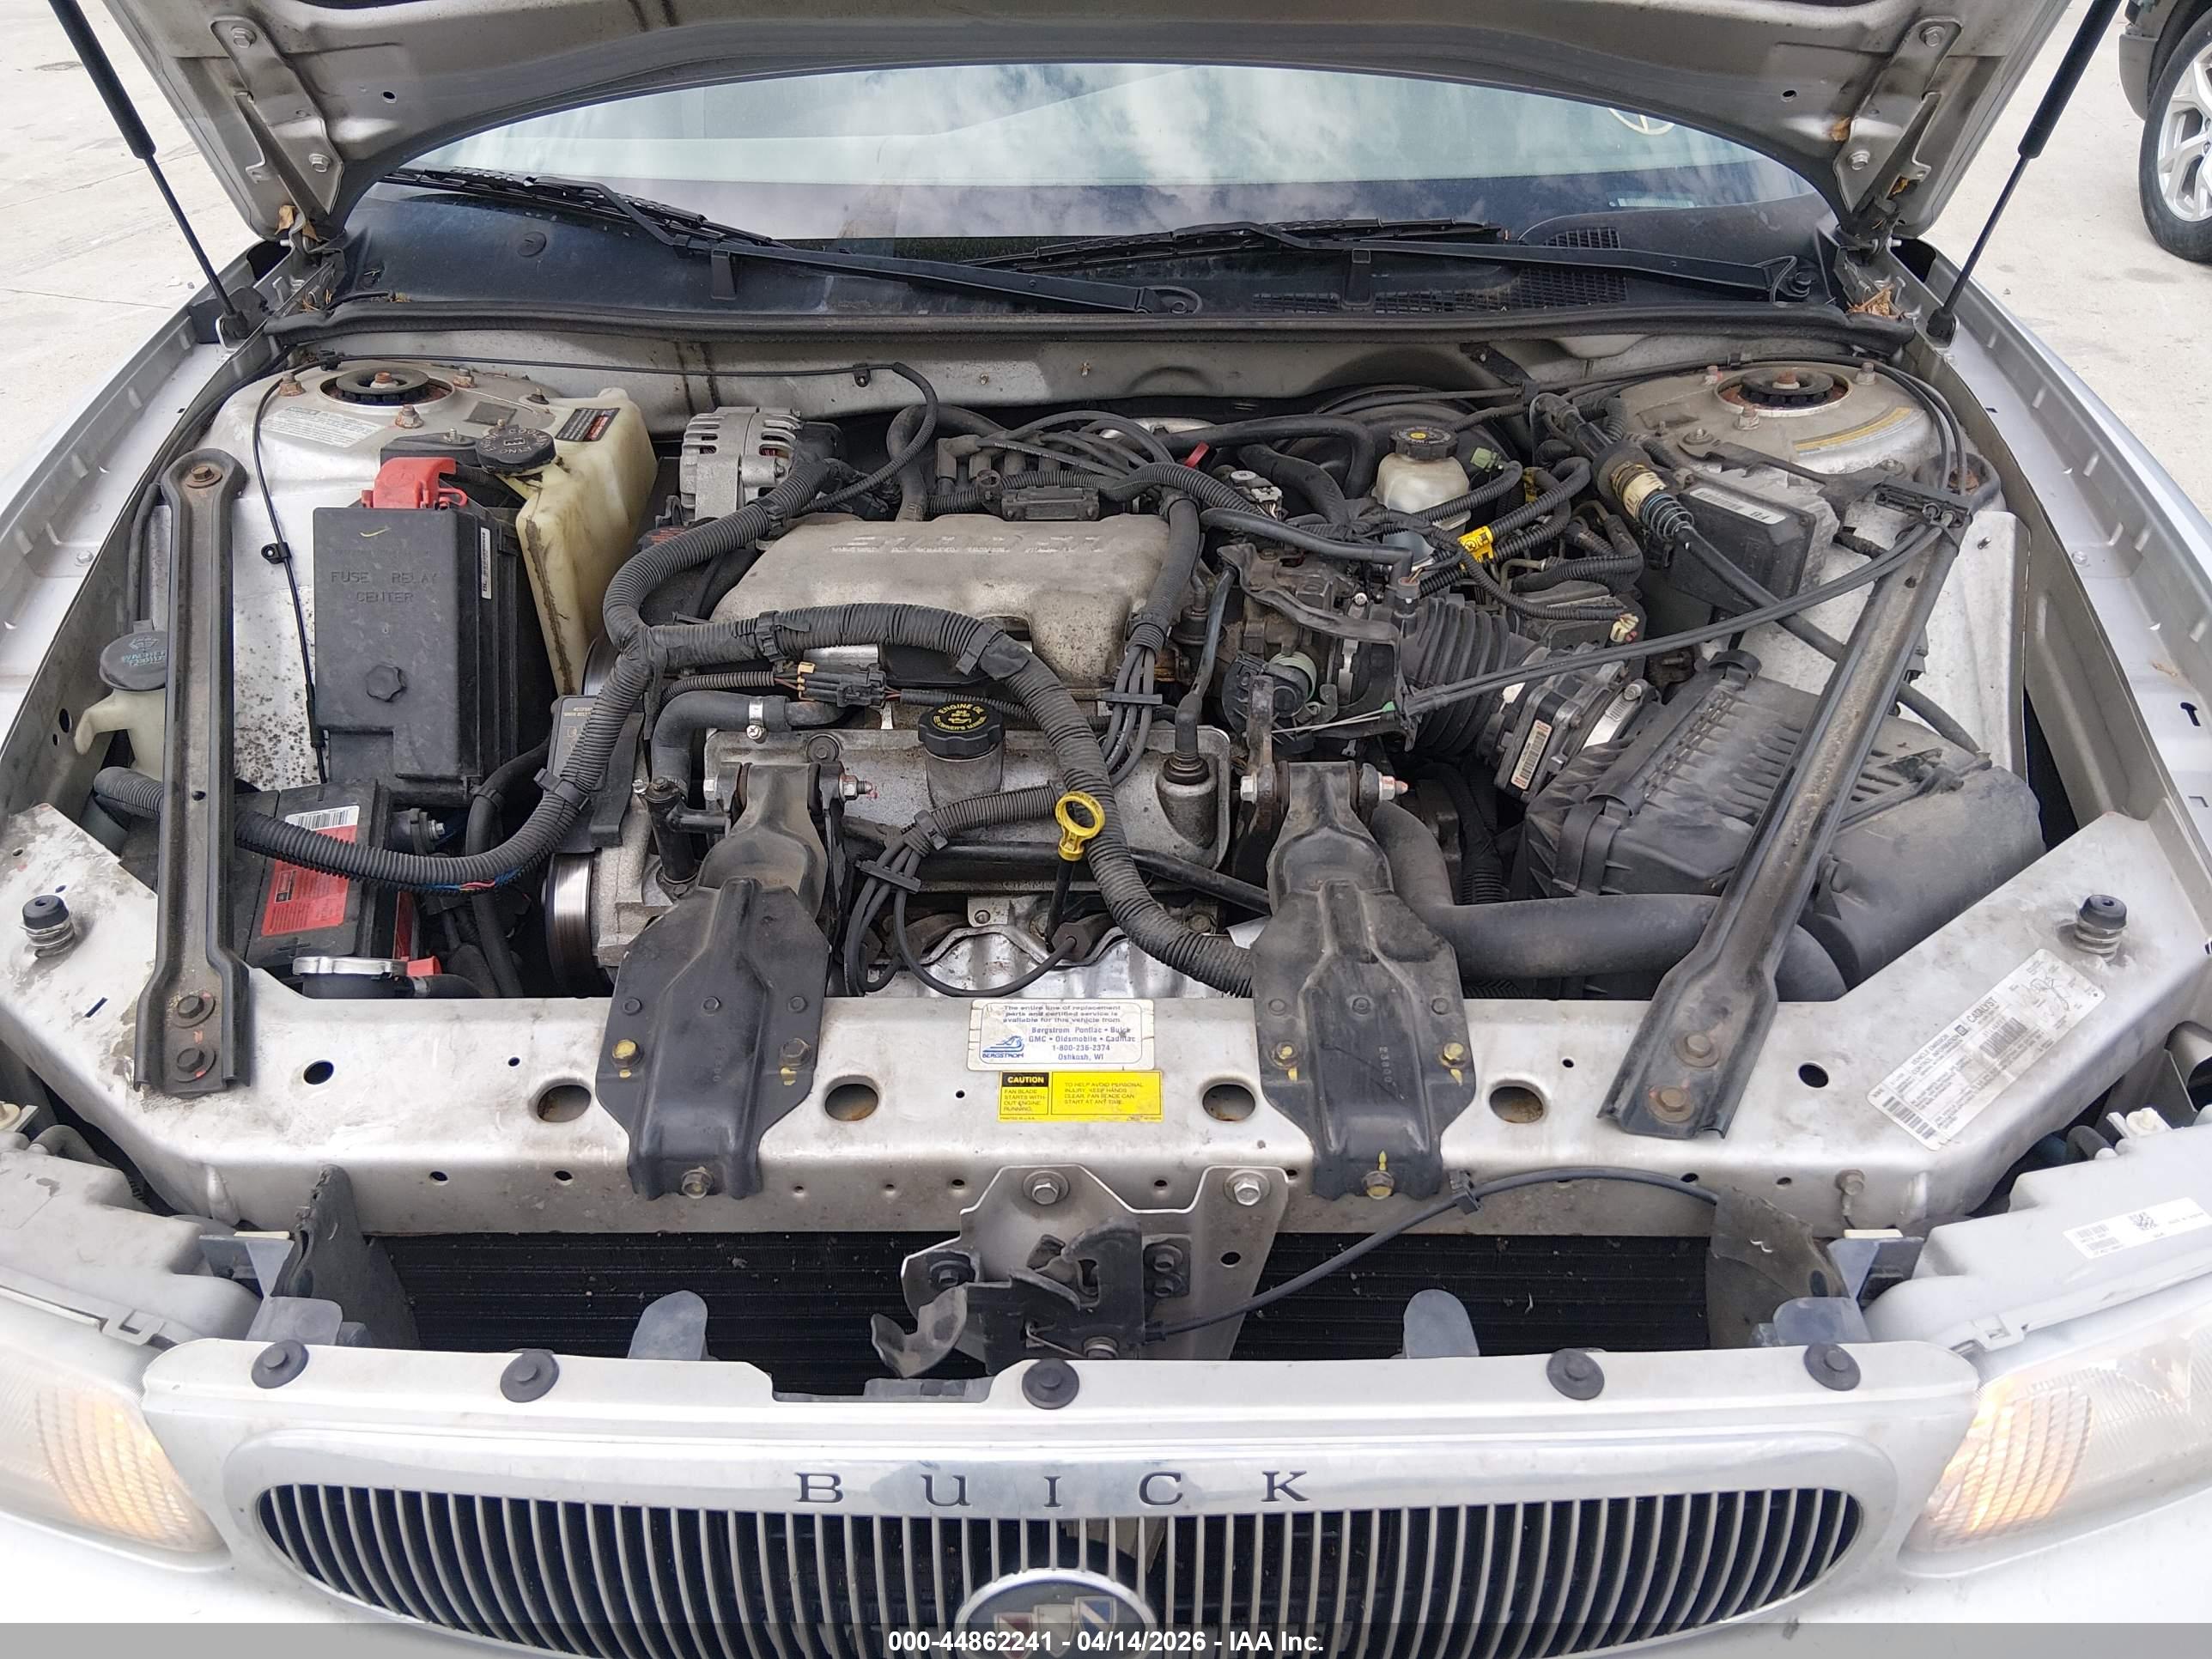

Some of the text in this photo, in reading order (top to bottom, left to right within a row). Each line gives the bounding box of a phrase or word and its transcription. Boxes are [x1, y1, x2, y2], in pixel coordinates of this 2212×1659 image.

[331, 571, 437, 584] FUSE RELAY
[356, 590, 413, 603] CENTER
[938, 704, 973, 714] ENGINE
[1966, 996, 1997, 1023] CATALYST
[795, 1470, 1311, 1508] BUICK
